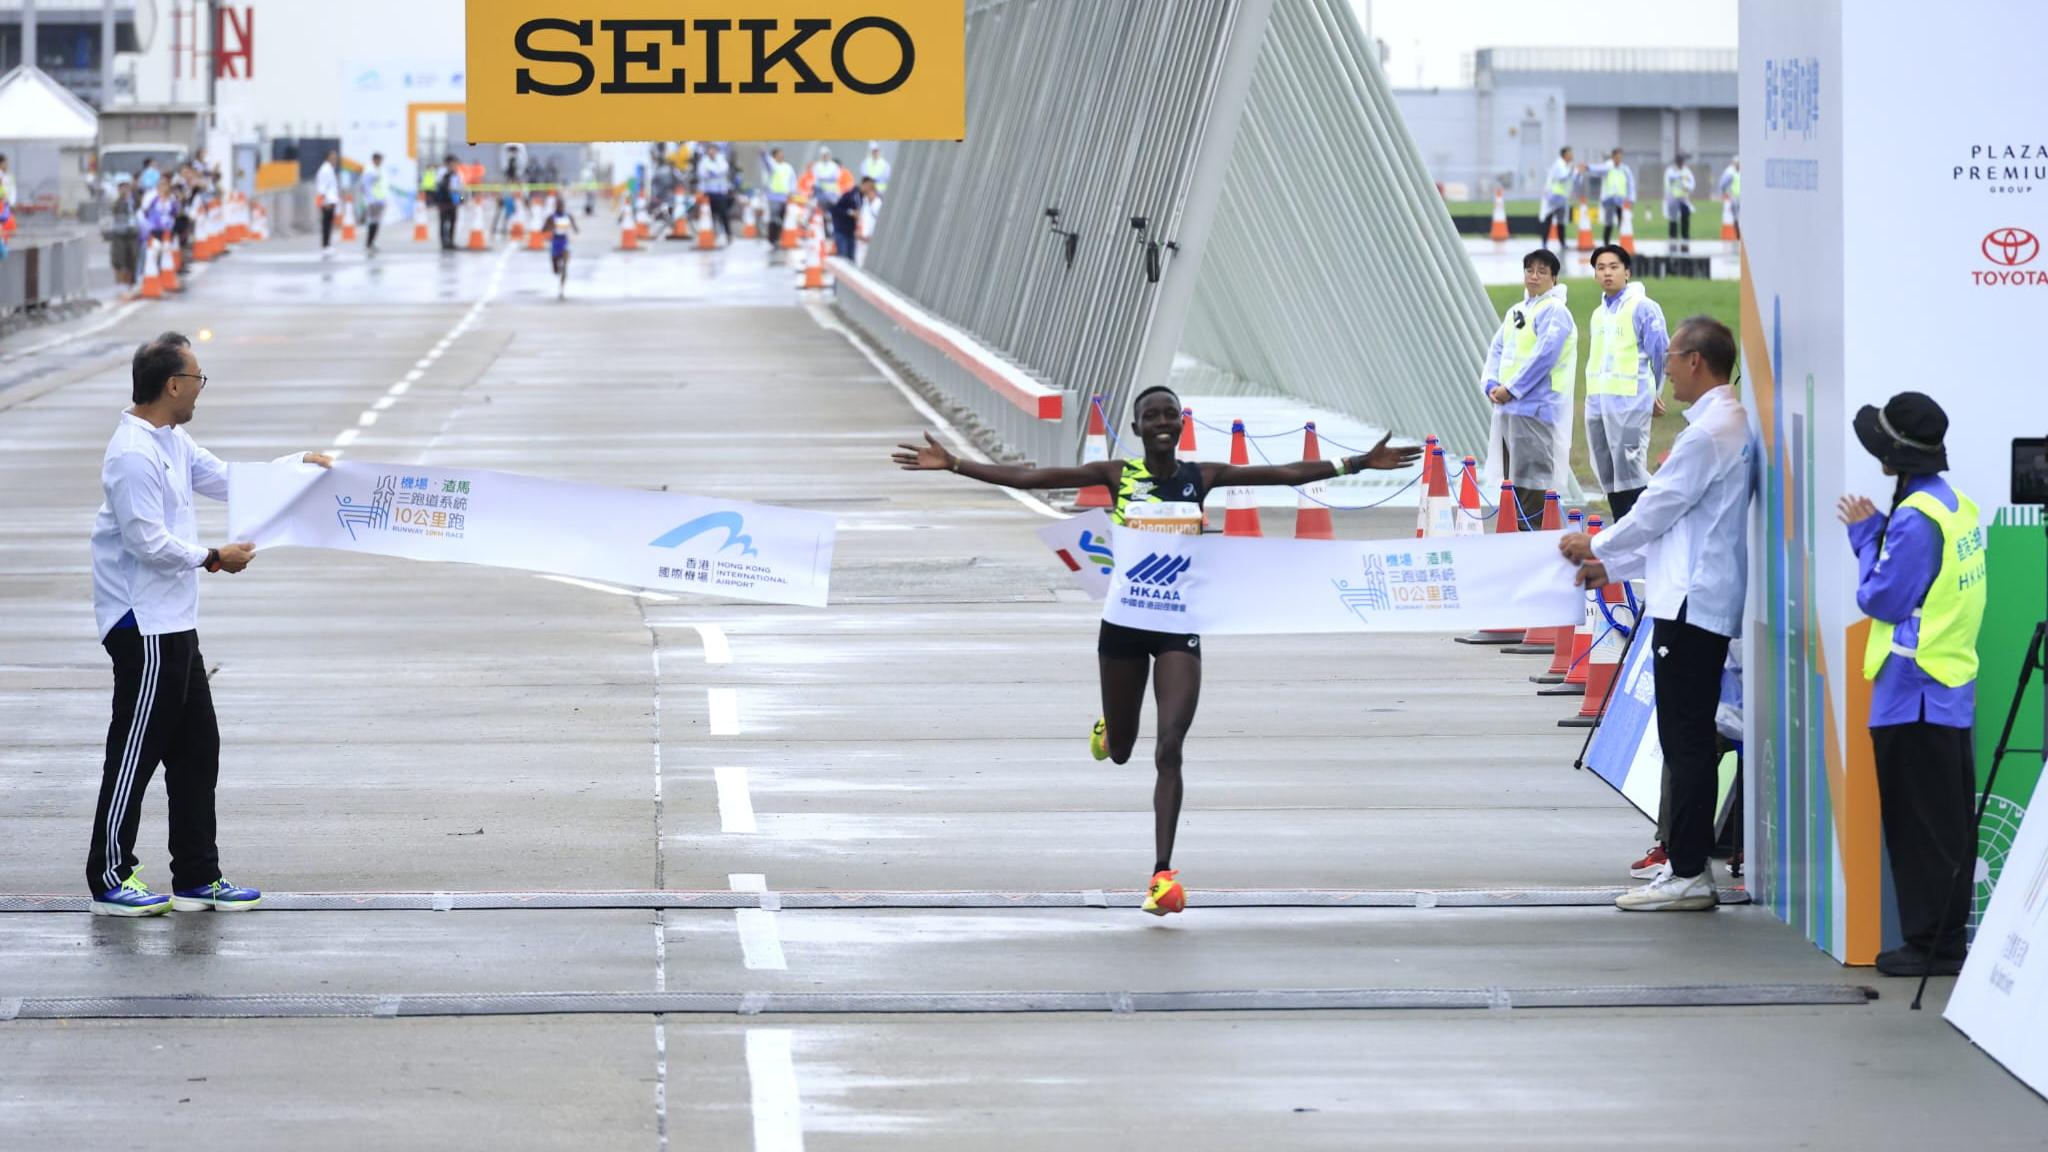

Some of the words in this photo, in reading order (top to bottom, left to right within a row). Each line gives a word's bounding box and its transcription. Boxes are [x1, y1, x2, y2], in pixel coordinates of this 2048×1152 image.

[514, 16, 915, 96] SEIKO
[1971, 145, 2048, 159] PLAZA
[1953, 166, 2047, 180] PREMIU
[1971, 271, 2048, 286] TOYOTA
[396, 492, 468, 511] 三跑道系統
[394, 507, 465, 531] 10公里跑
[392, 525, 424, 536] RUNWAY
[445, 531, 464, 539] RACE
[686, 557, 710, 571] 香港
[717, 561, 744, 570] HONG
[745, 565, 772, 574] KONG
[715, 579, 755, 588] AIRPORT
[716, 570, 789, 584] INTERNATIONAL
[1130, 586, 1181, 601] HKAAA
[1391, 585, 1459, 602] 10公里跑
